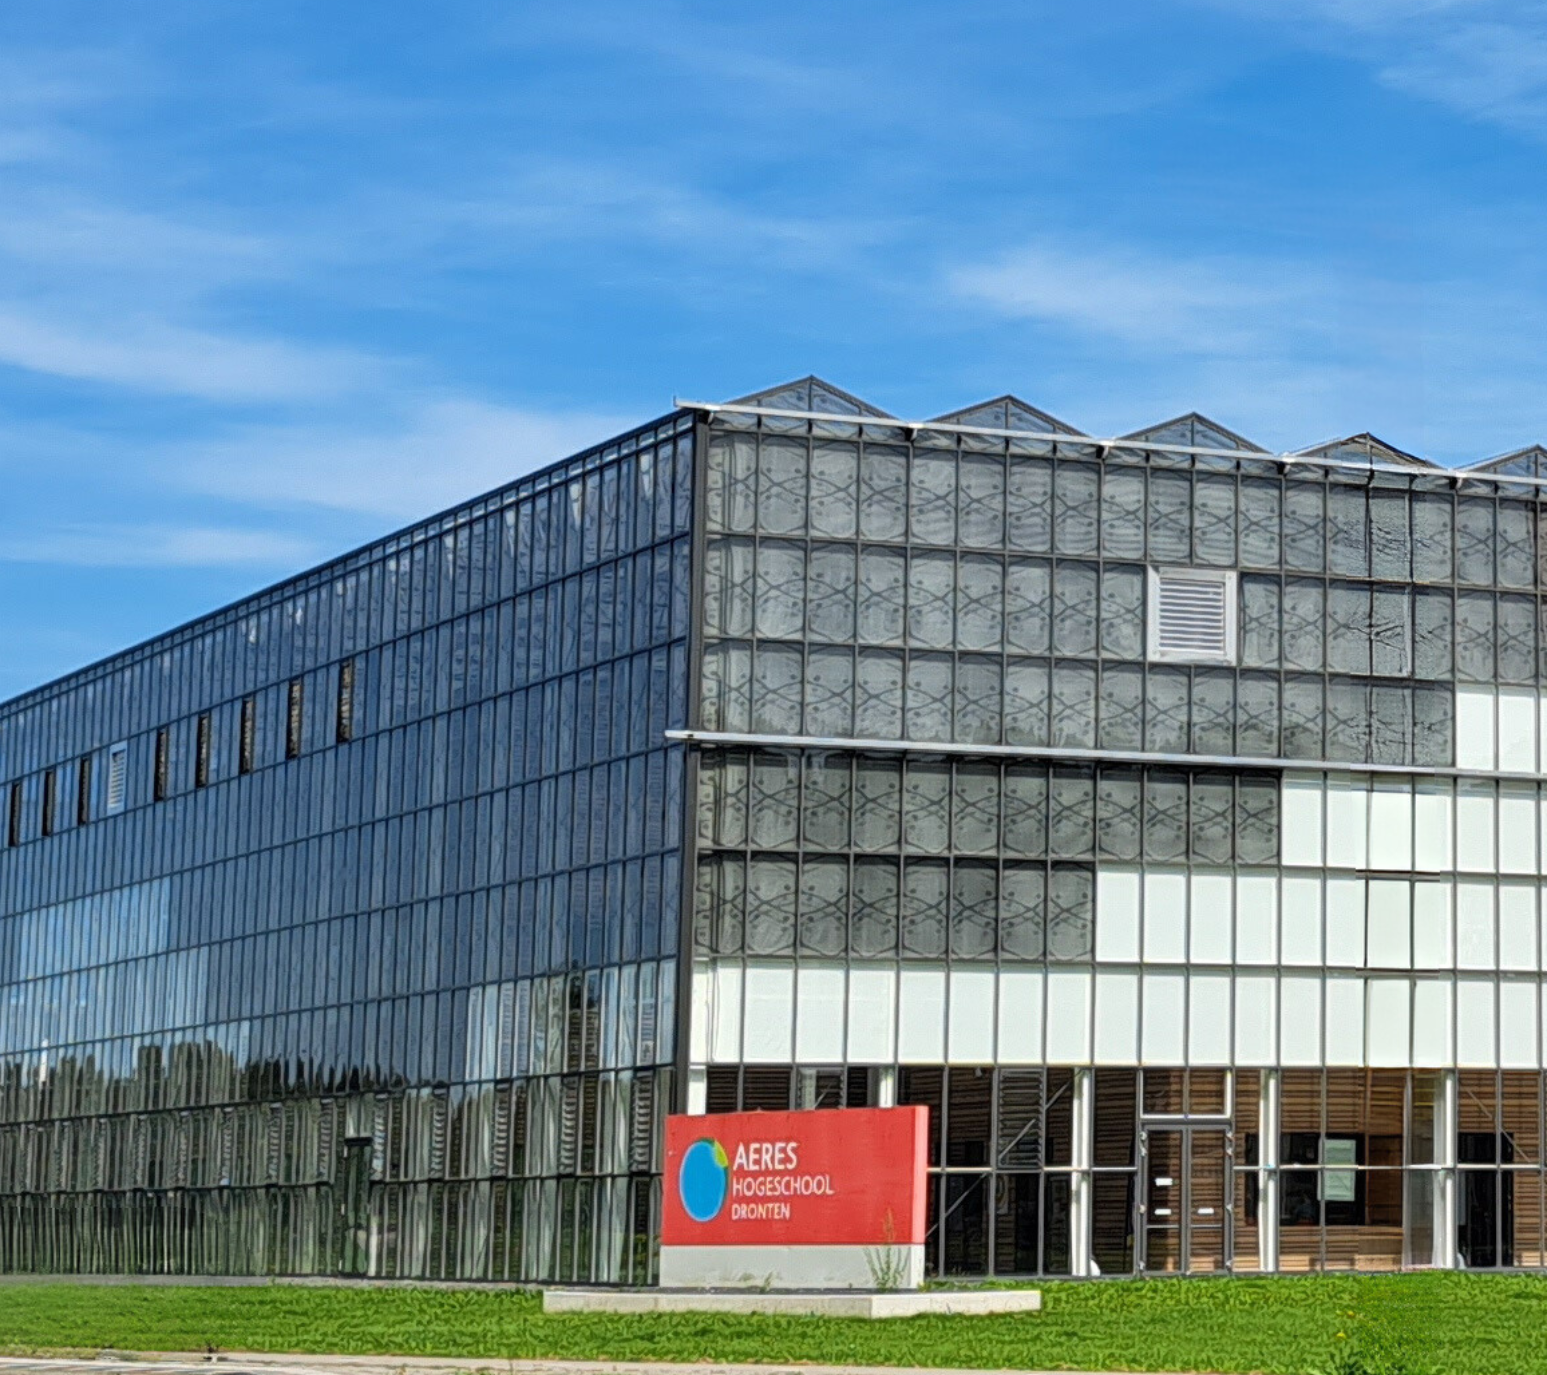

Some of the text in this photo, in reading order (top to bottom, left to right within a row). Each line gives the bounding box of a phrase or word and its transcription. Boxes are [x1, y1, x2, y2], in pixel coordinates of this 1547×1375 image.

[733, 1142, 799, 1171] AERES
[733, 1174, 835, 1197] HOGESCHOOL
[731, 1203, 791, 1220] DRONTEN
